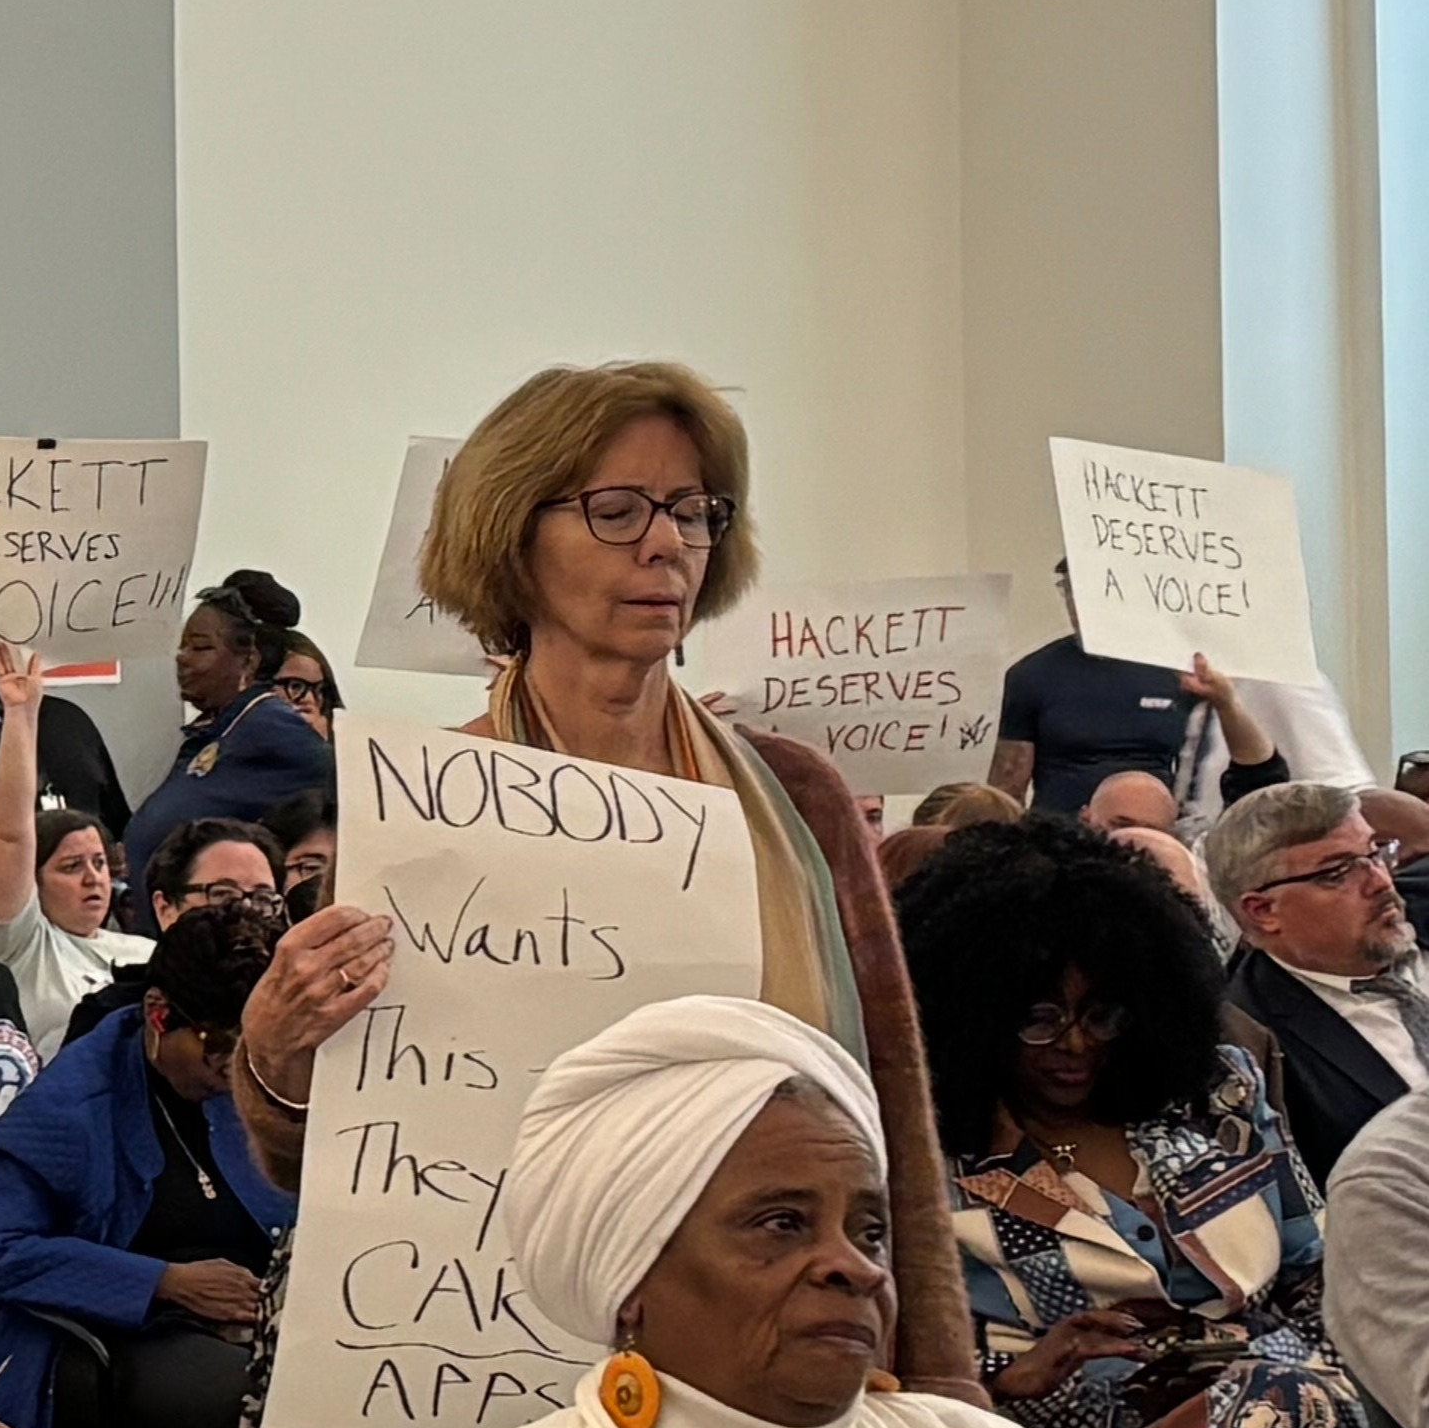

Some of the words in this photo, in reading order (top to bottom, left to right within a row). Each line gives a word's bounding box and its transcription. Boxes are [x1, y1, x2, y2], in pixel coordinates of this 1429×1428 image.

[1083, 456, 1208, 519] HACKETT
[1092, 514, 1242, 569] DESERVES
[1105, 567, 1124, 601] A
[771, 606, 966, 659] HACKETT
[760, 671, 962, 714] DESERVES
[368, 737, 708, 891] NOBODY
[383, 876, 625, 980] Wants
[356, 1004, 499, 1091] This
[336, 1120, 508, 1252] They
